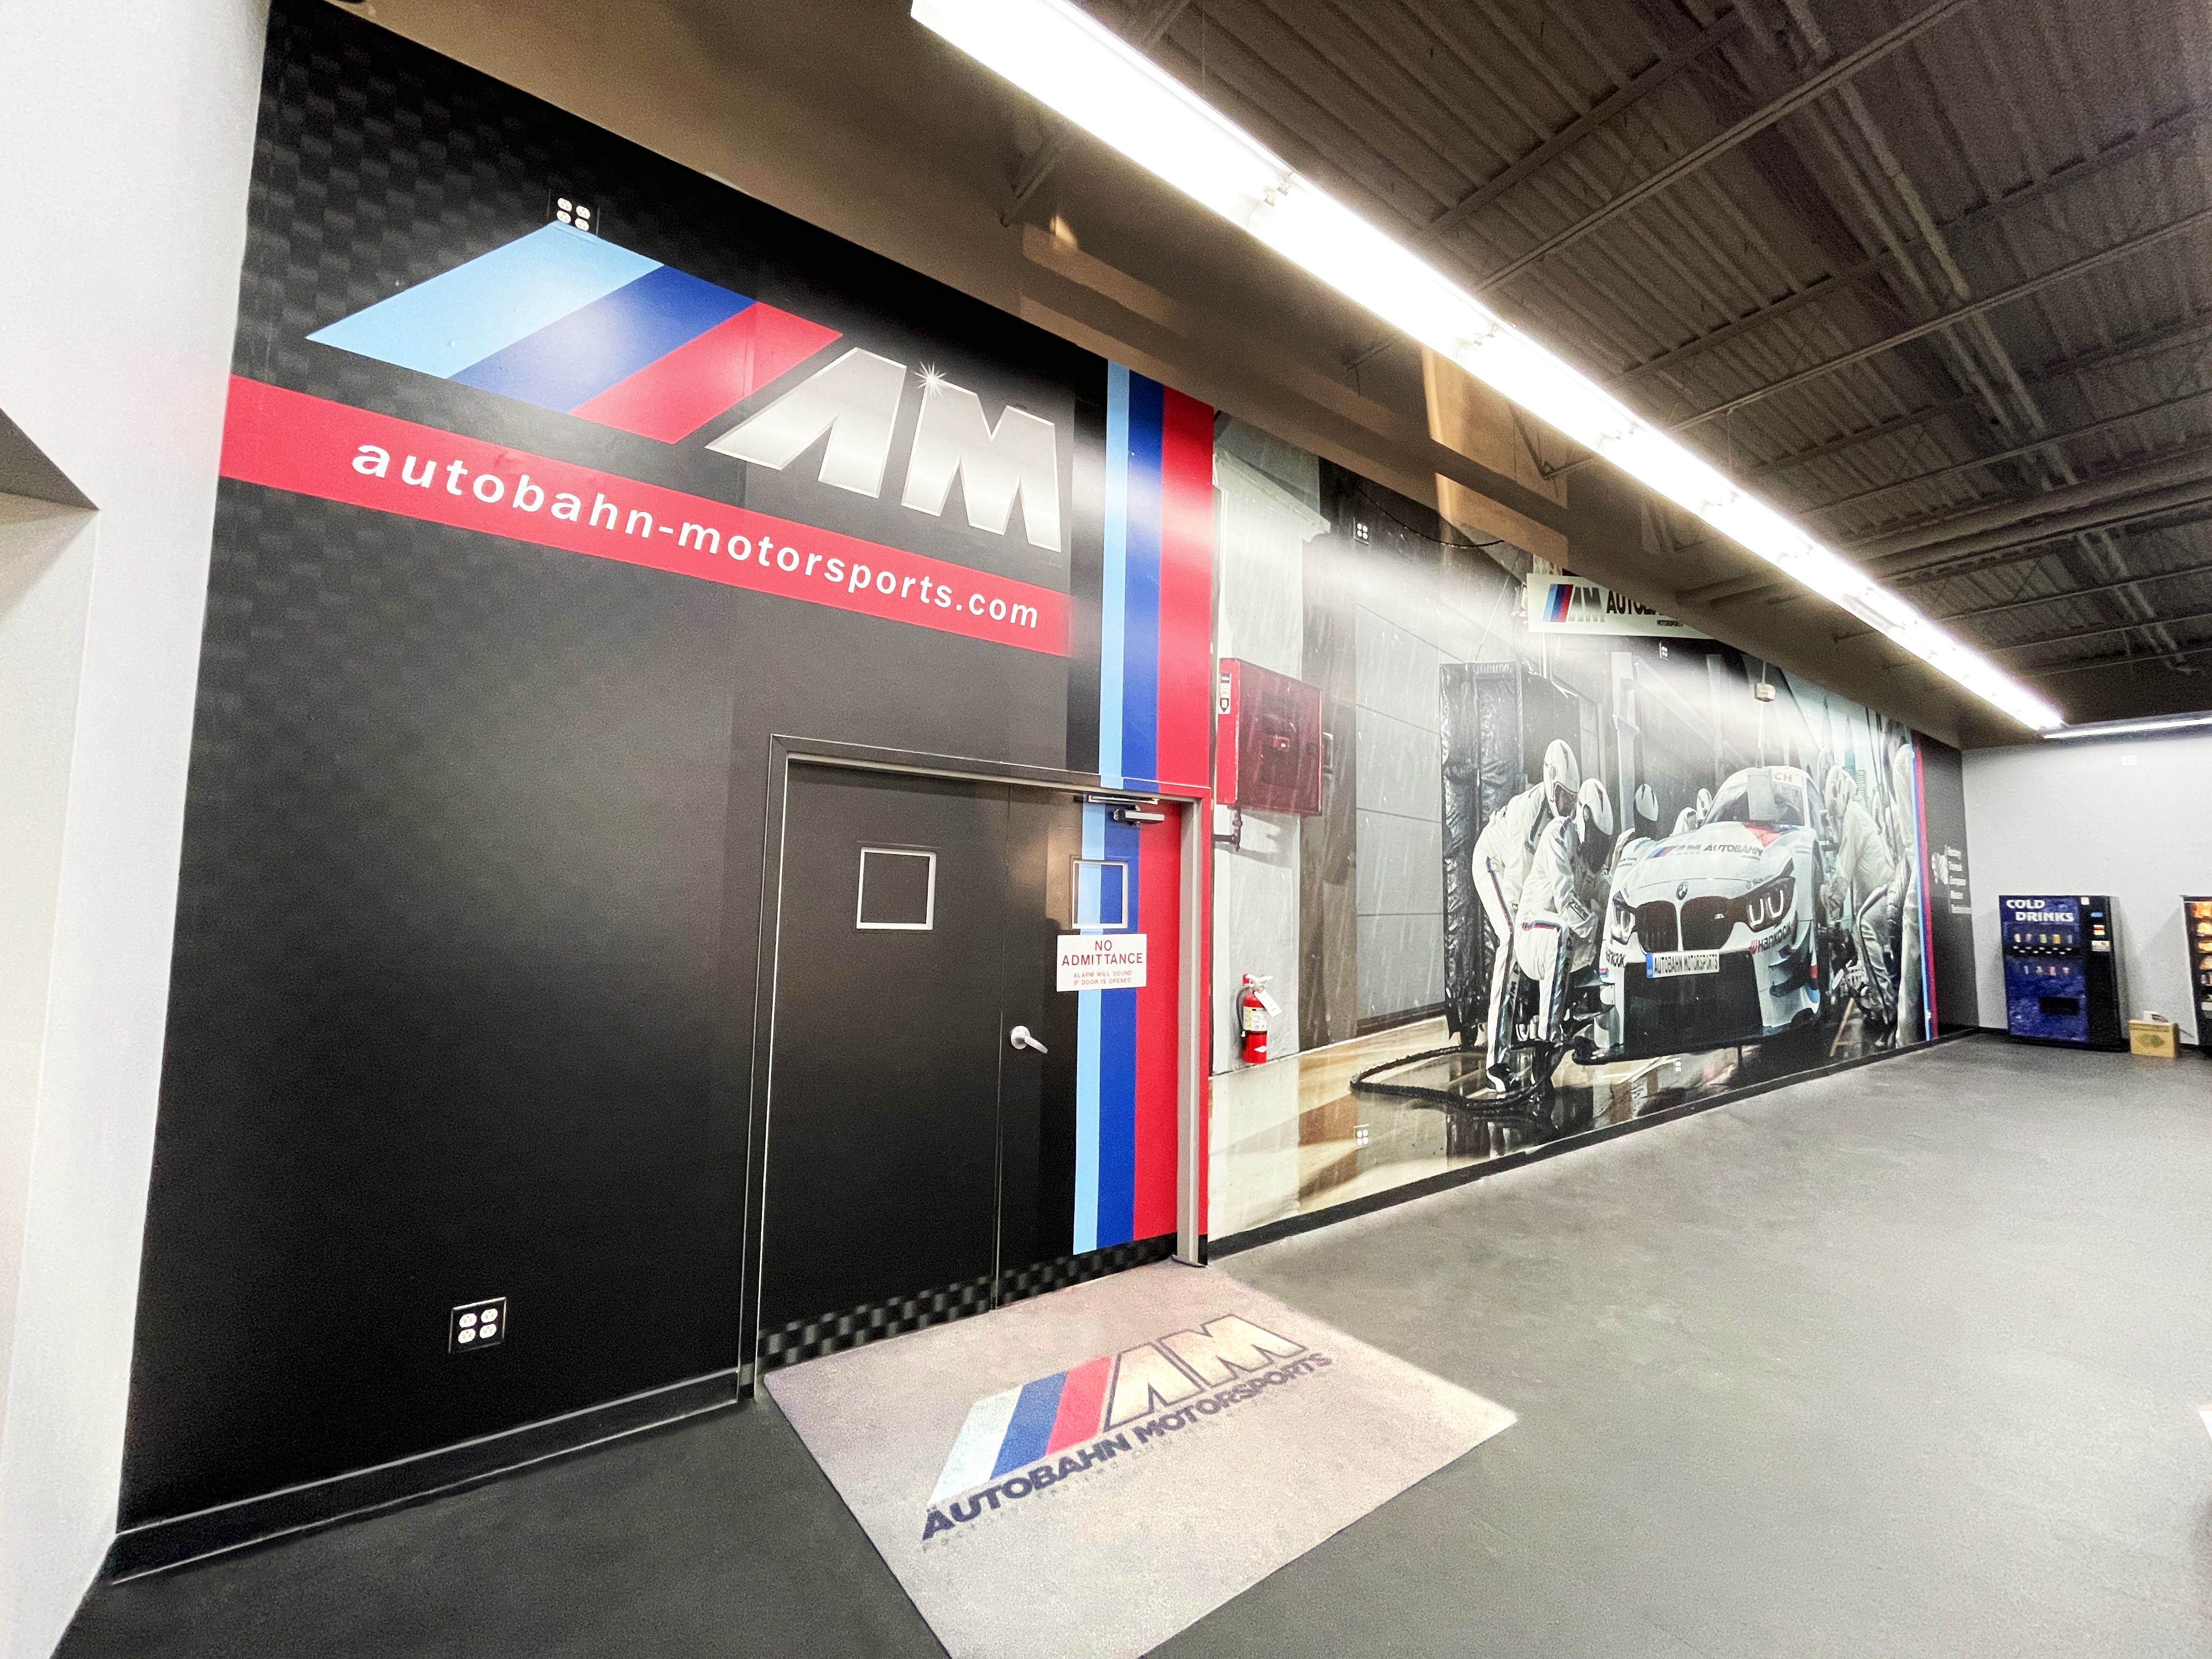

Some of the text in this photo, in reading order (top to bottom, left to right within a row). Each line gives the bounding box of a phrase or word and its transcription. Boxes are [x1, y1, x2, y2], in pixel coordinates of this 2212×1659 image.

[352, 444, 1039, 629] autobahn-motorsports.com
[1703, 844, 1763, 857] AUTOBAHN
[2006, 899, 2046, 909] COLD
[2015, 911, 2075, 922] DRINKS
[1095, 940, 1112, 951] NO
[1062, 953, 1143, 966] ADMITTANCE
[922, 1352, 1333, 1541] AUTOBAHN MOTORSPORTS
